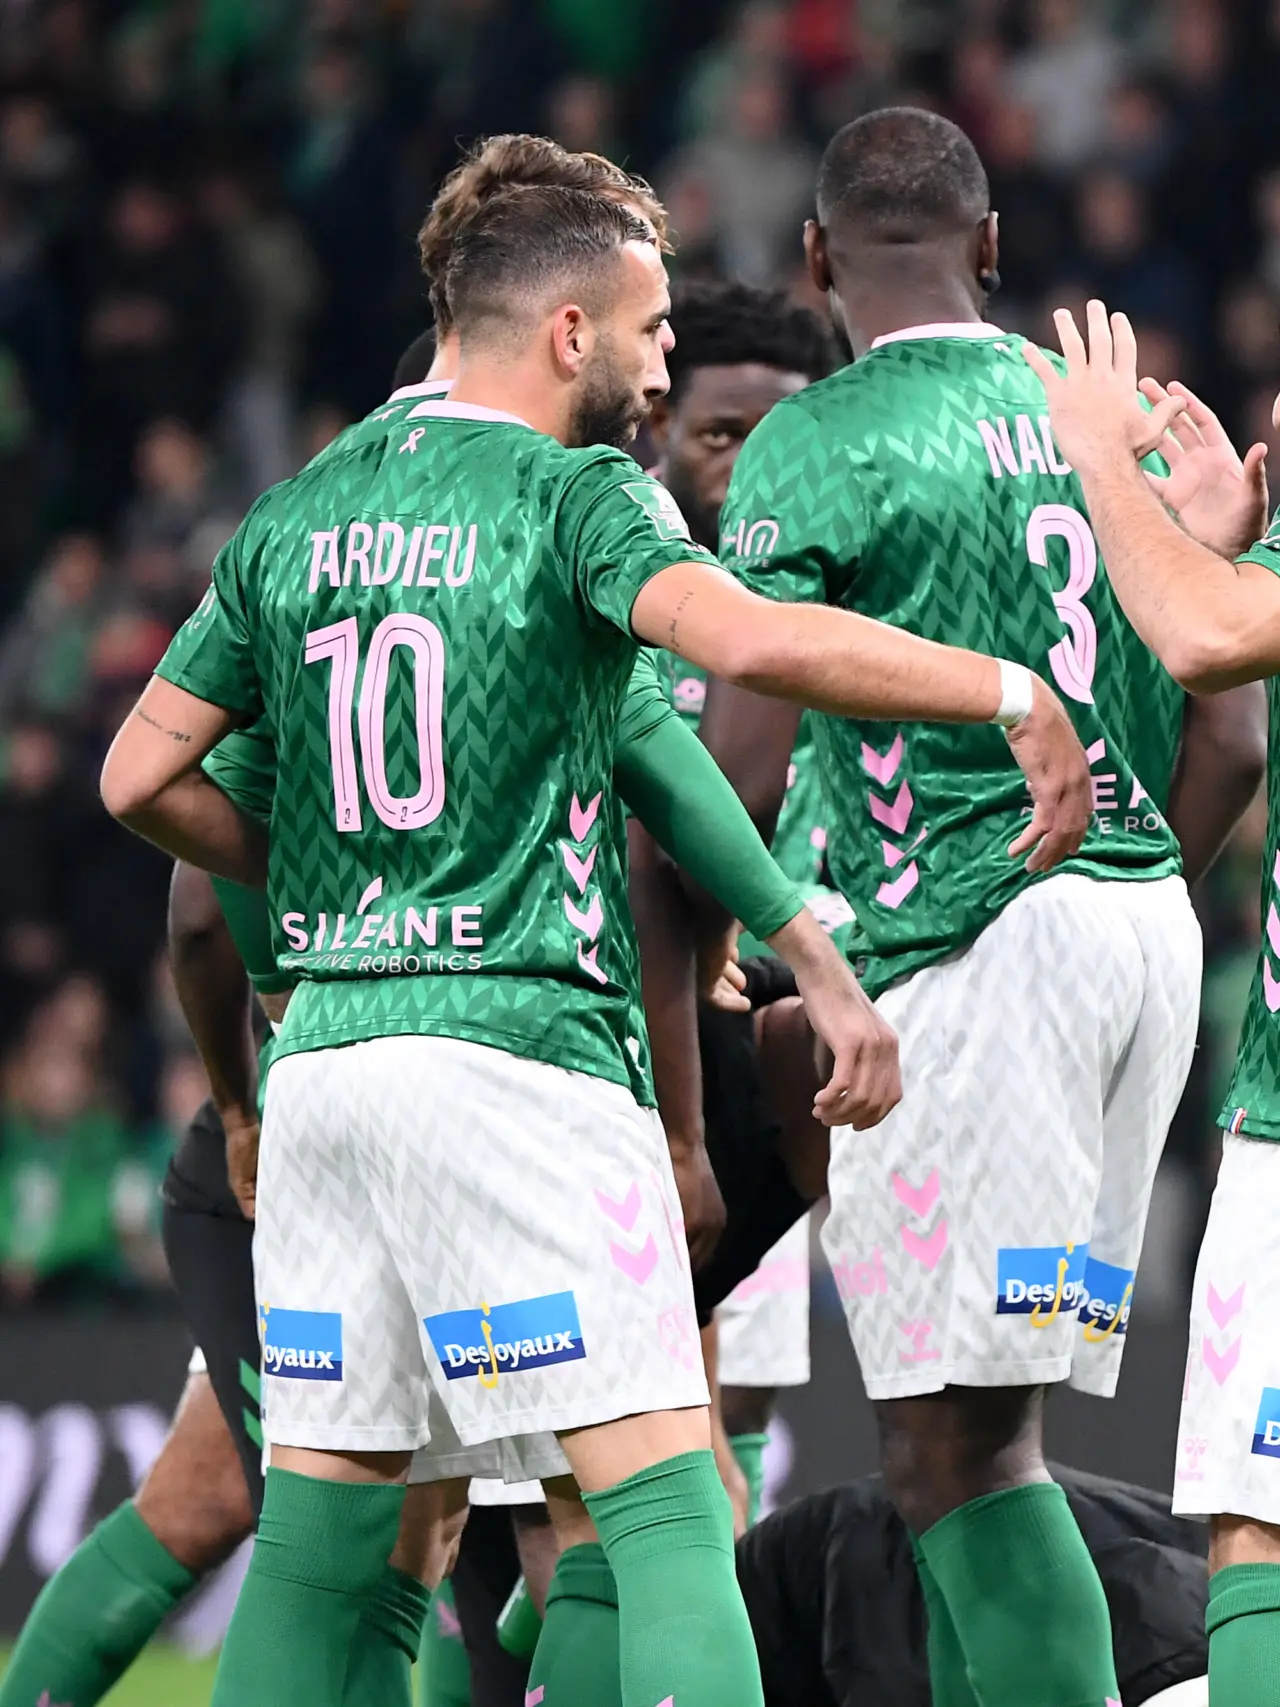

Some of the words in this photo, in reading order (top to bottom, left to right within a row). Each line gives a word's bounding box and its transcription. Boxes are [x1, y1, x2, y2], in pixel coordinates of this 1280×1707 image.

[308, 521, 478, 594] TARDIEU
[1026, 503, 1098, 705] 3
[304, 612, 447, 833] 10
[357, 954, 483, 973] ROBOTICS
